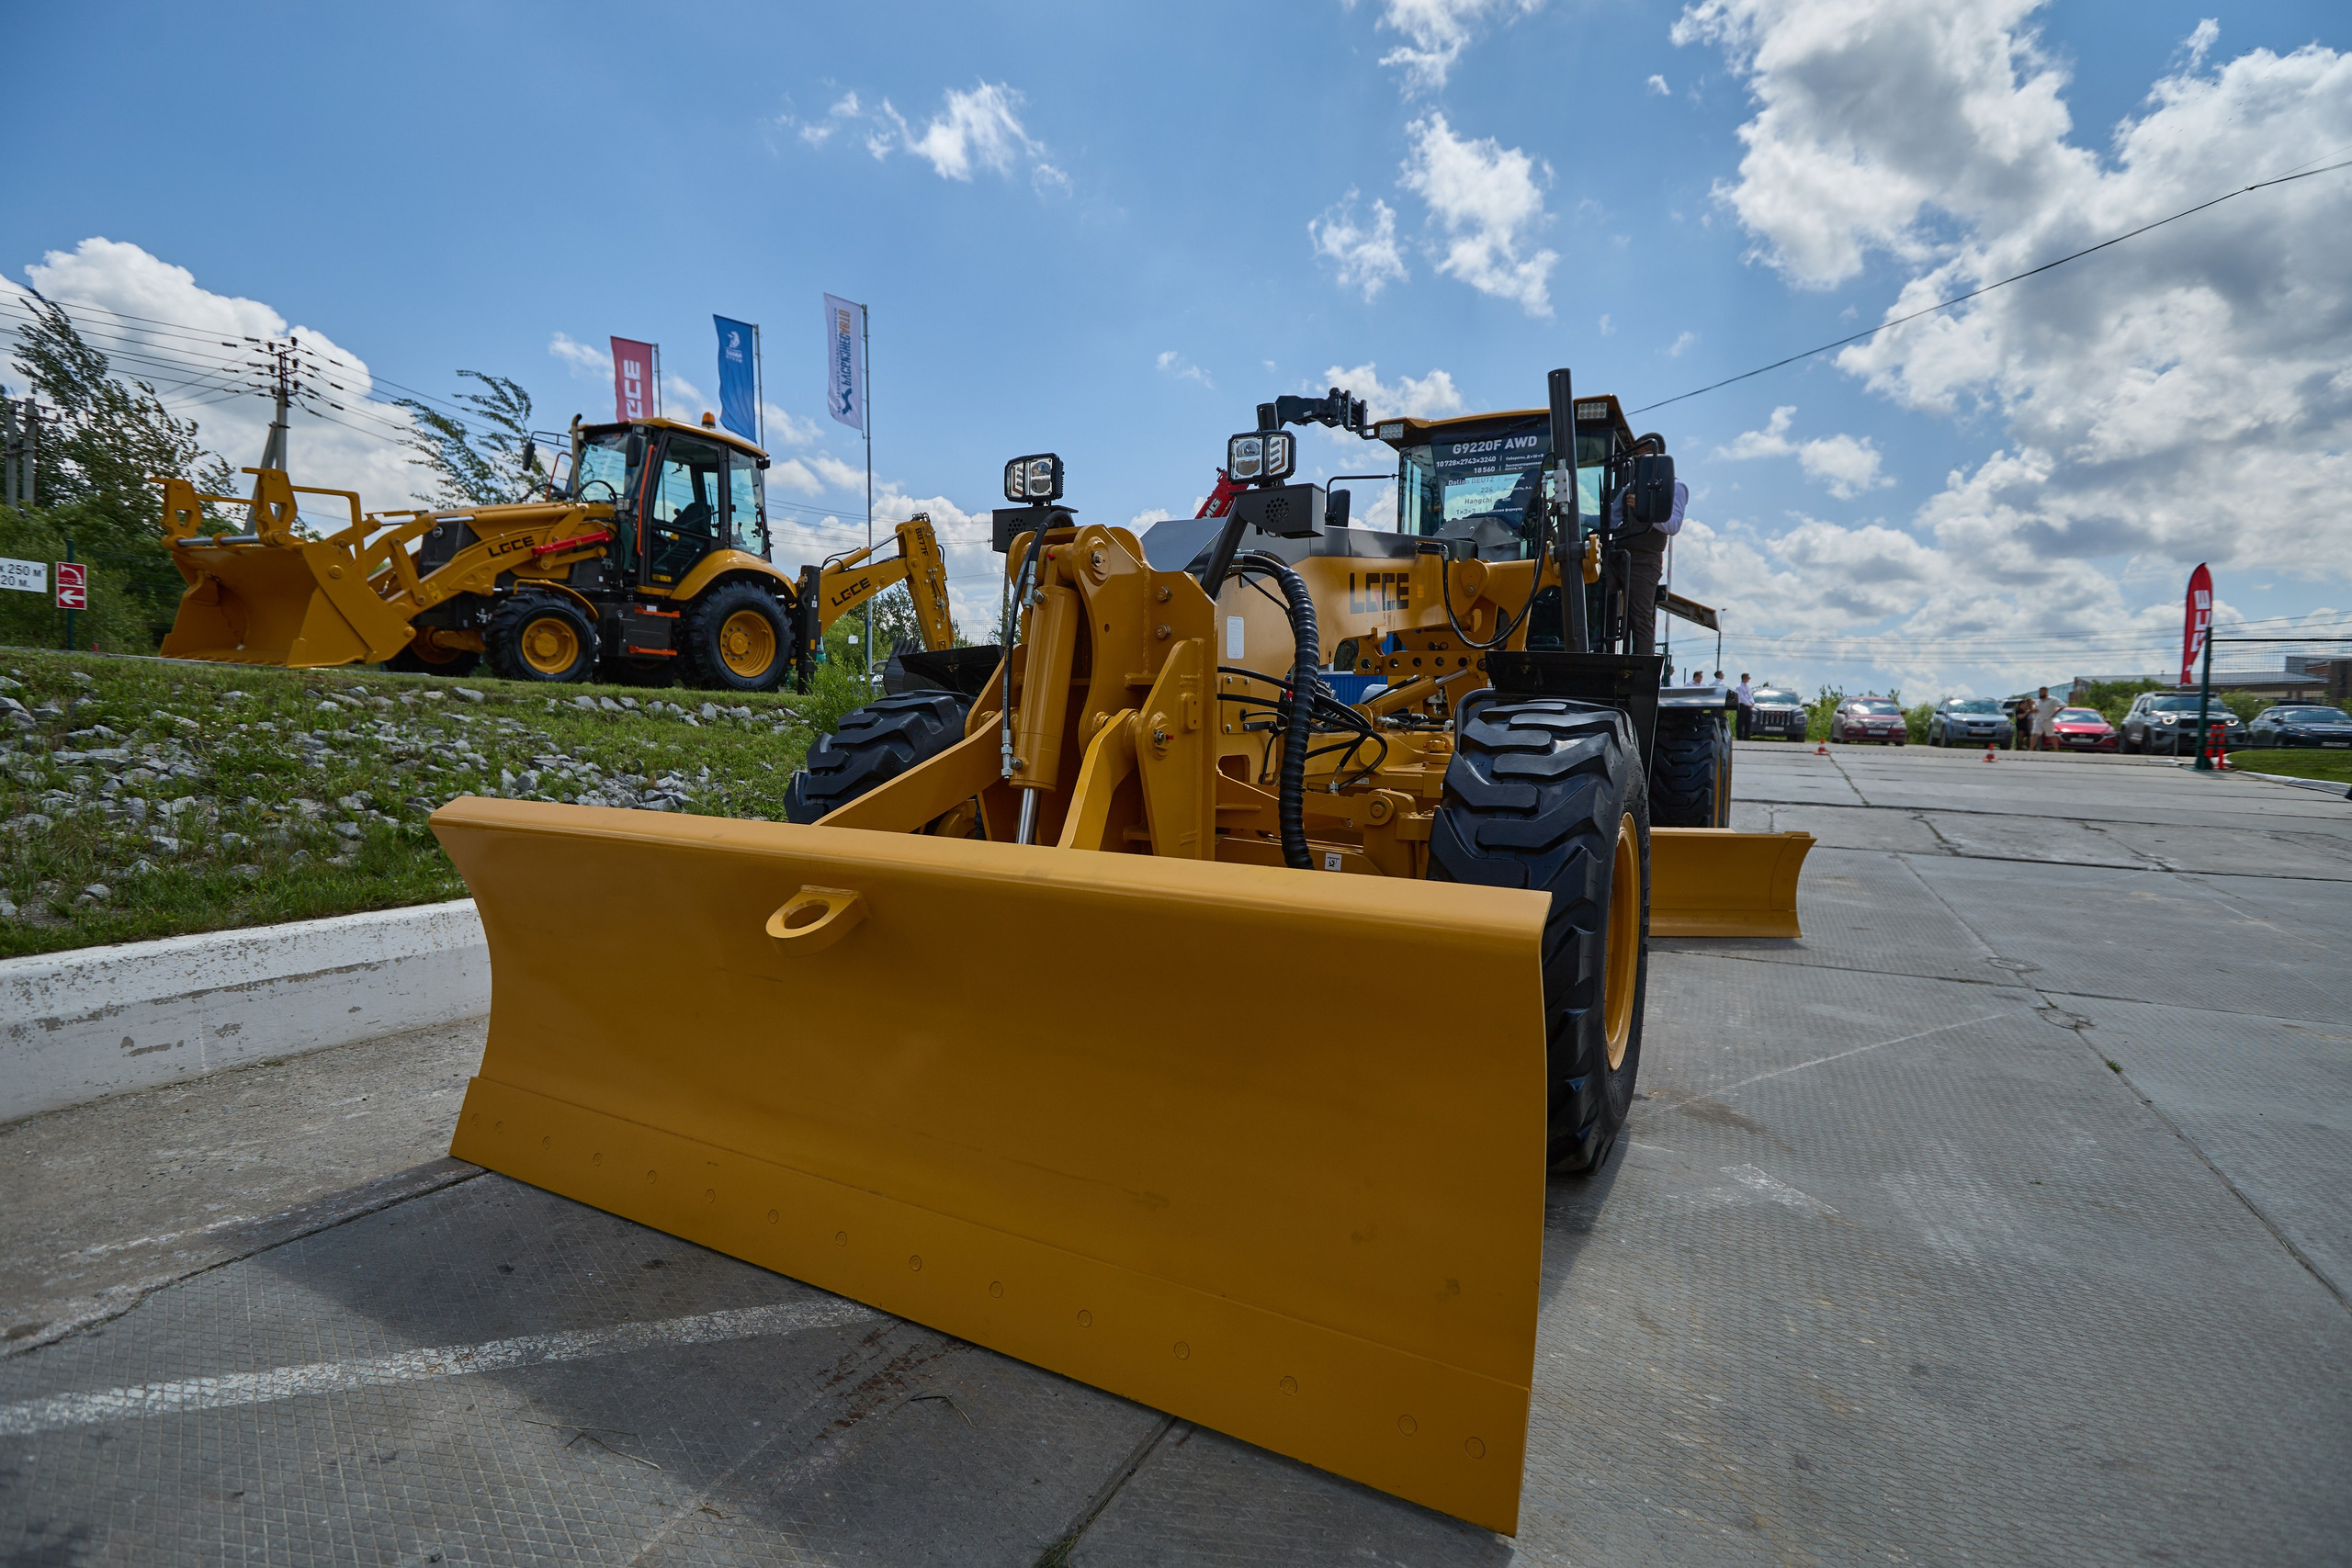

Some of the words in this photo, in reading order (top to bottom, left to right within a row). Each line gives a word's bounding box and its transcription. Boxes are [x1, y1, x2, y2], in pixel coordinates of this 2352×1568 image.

[623, 359, 642, 422] GCE
[1453, 439, 1502, 455] G9220F
[1504, 435, 1538, 450] AWD
[1448, 477, 1470, 487] Dalian
[1471, 476, 1495, 484] DEUTZ
[1464, 497, 1493, 505] Hangchi
[7, 563, 30, 577] 250
